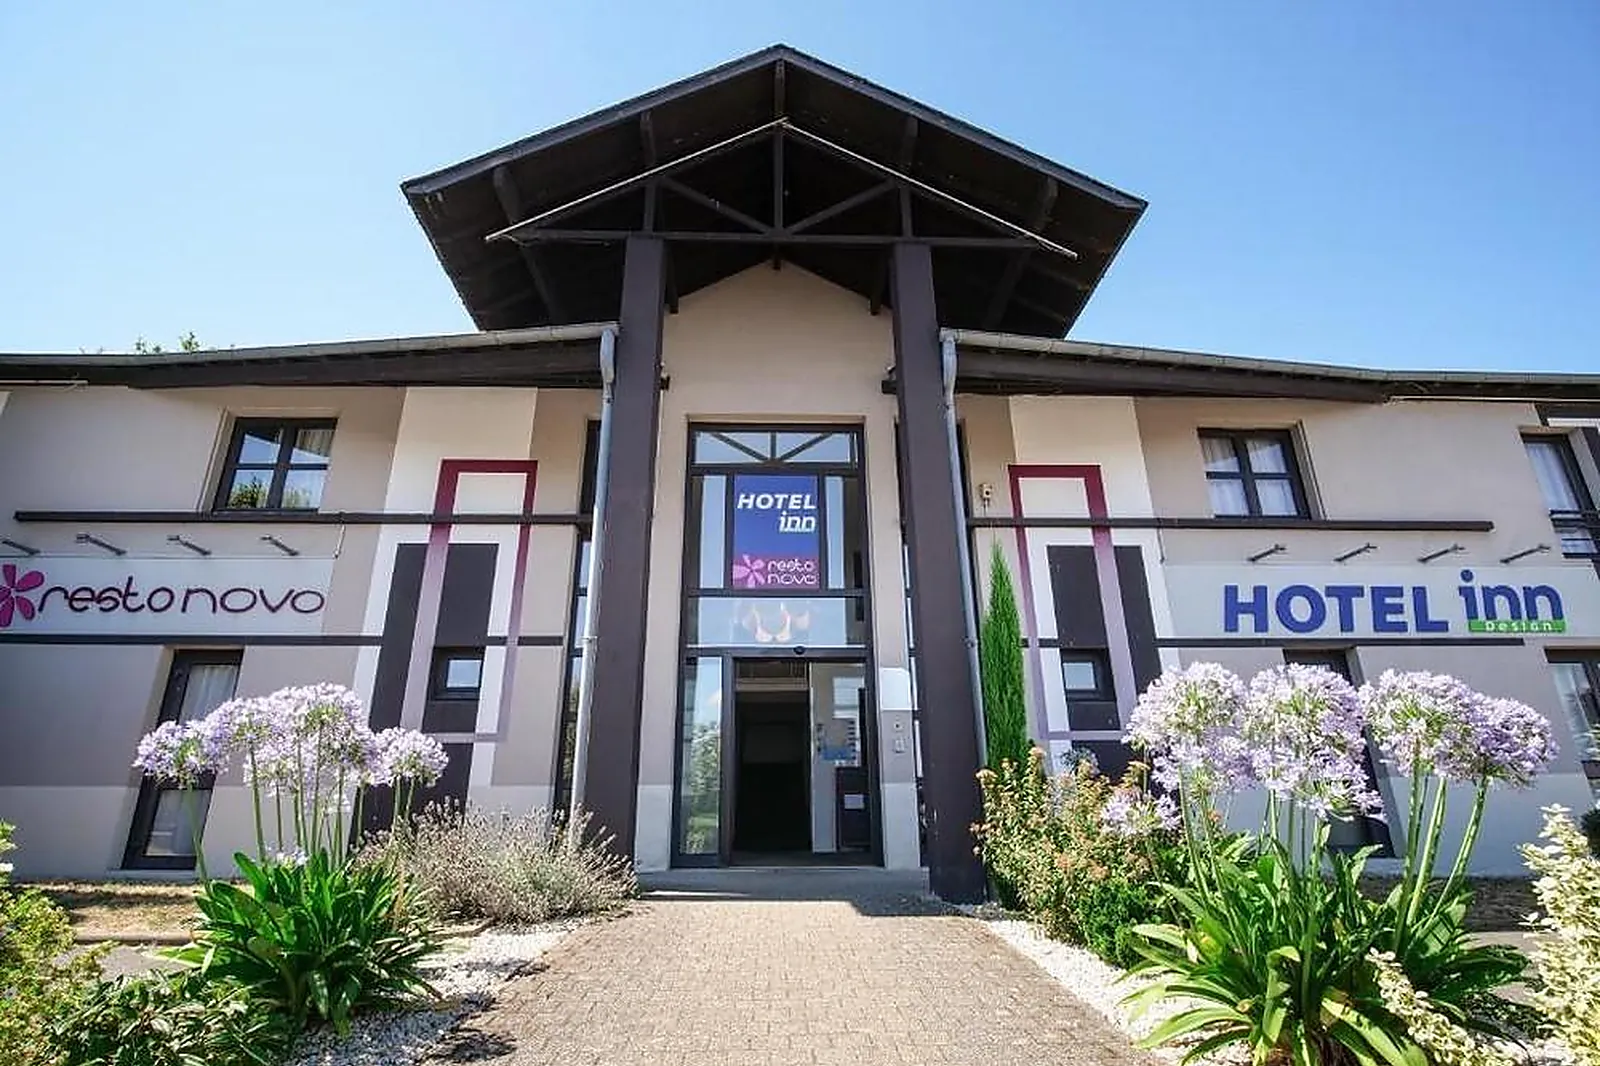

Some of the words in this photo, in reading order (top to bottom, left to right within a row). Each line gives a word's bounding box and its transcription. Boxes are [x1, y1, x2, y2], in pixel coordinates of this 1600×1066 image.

[737, 493, 817, 510] HOTEL
[779, 510, 816, 532] inn
[767, 559, 815, 573] resto
[767, 573, 817, 585] novo
[1223, 584, 1449, 633] HOTEL
[1458, 569, 1564, 621] inn
